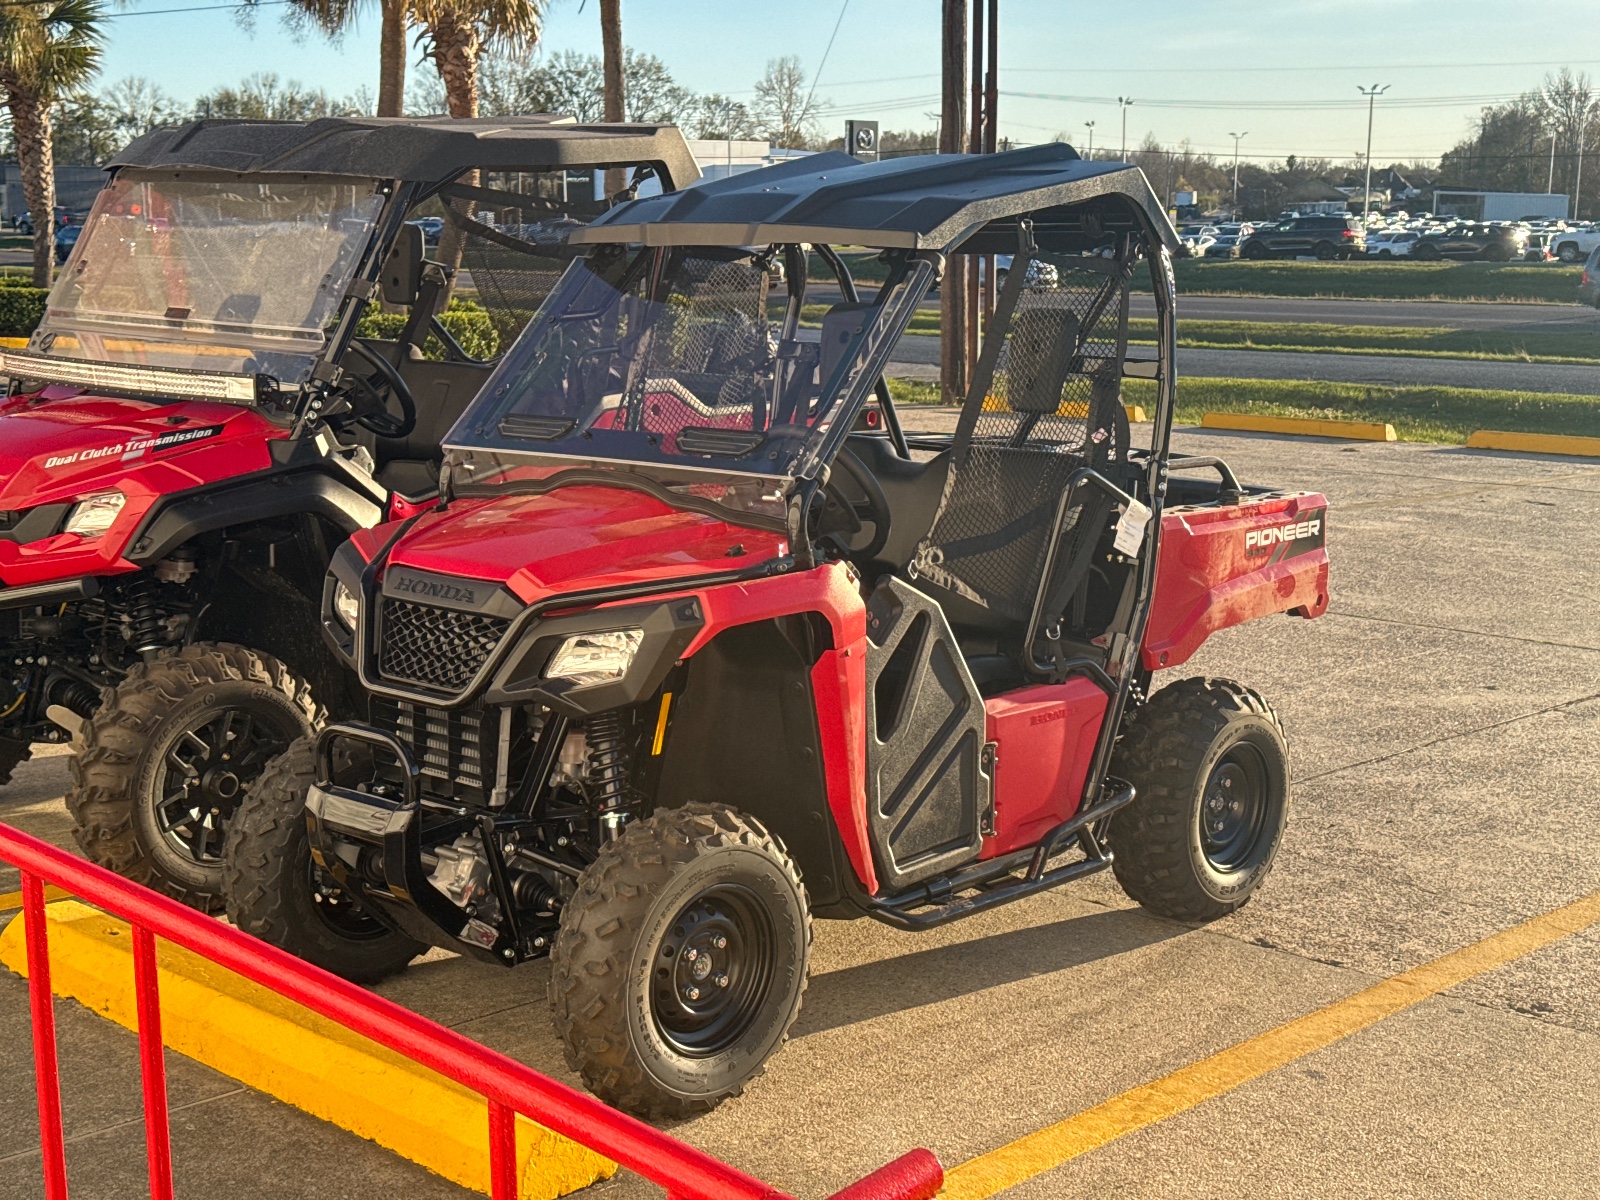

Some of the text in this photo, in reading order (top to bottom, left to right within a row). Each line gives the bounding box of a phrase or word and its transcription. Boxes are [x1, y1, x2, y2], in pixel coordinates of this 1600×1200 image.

[44, 428, 213, 469] Dual Clutch Transmission
[1246, 519, 1320, 549] PIONEER
[394, 577, 475, 603] HONDA
